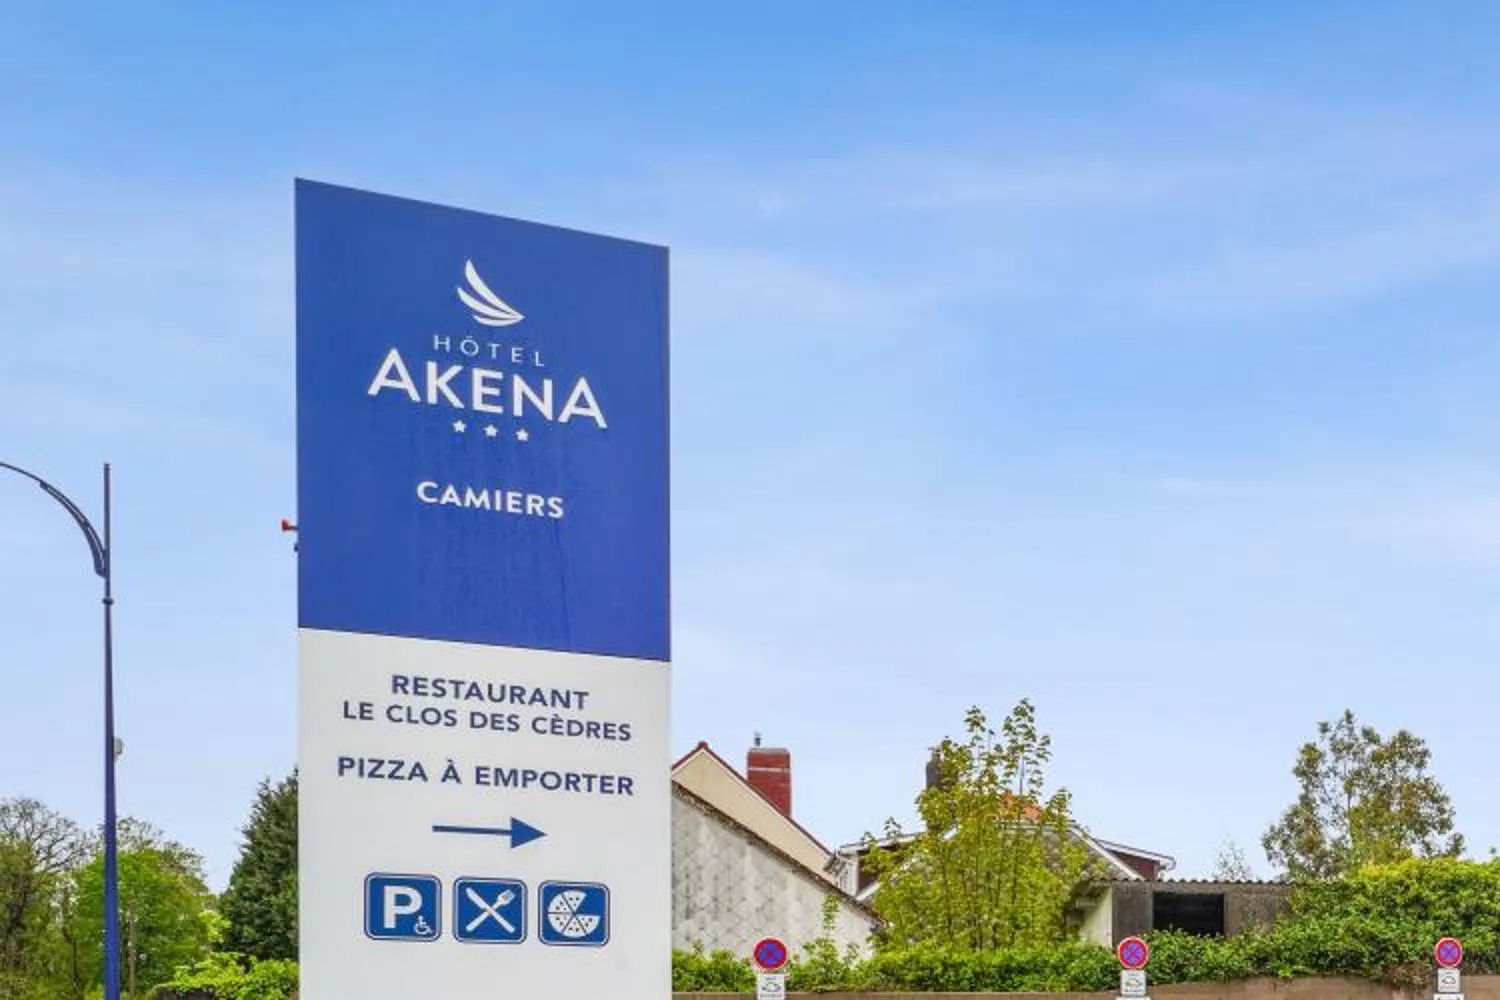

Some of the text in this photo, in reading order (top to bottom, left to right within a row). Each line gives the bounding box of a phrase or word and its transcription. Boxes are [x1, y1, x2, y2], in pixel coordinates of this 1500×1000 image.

[434, 334, 545, 367] HÔTEL
[367, 348, 608, 428] AKENA
[416, 481, 565, 519] CAMIERS
[391, 674, 590, 711] RESTAURANT
[342, 700, 633, 742] LE CLOS DES CÈDRES
[337, 755, 634, 797] PIZZA À EMPORTER
